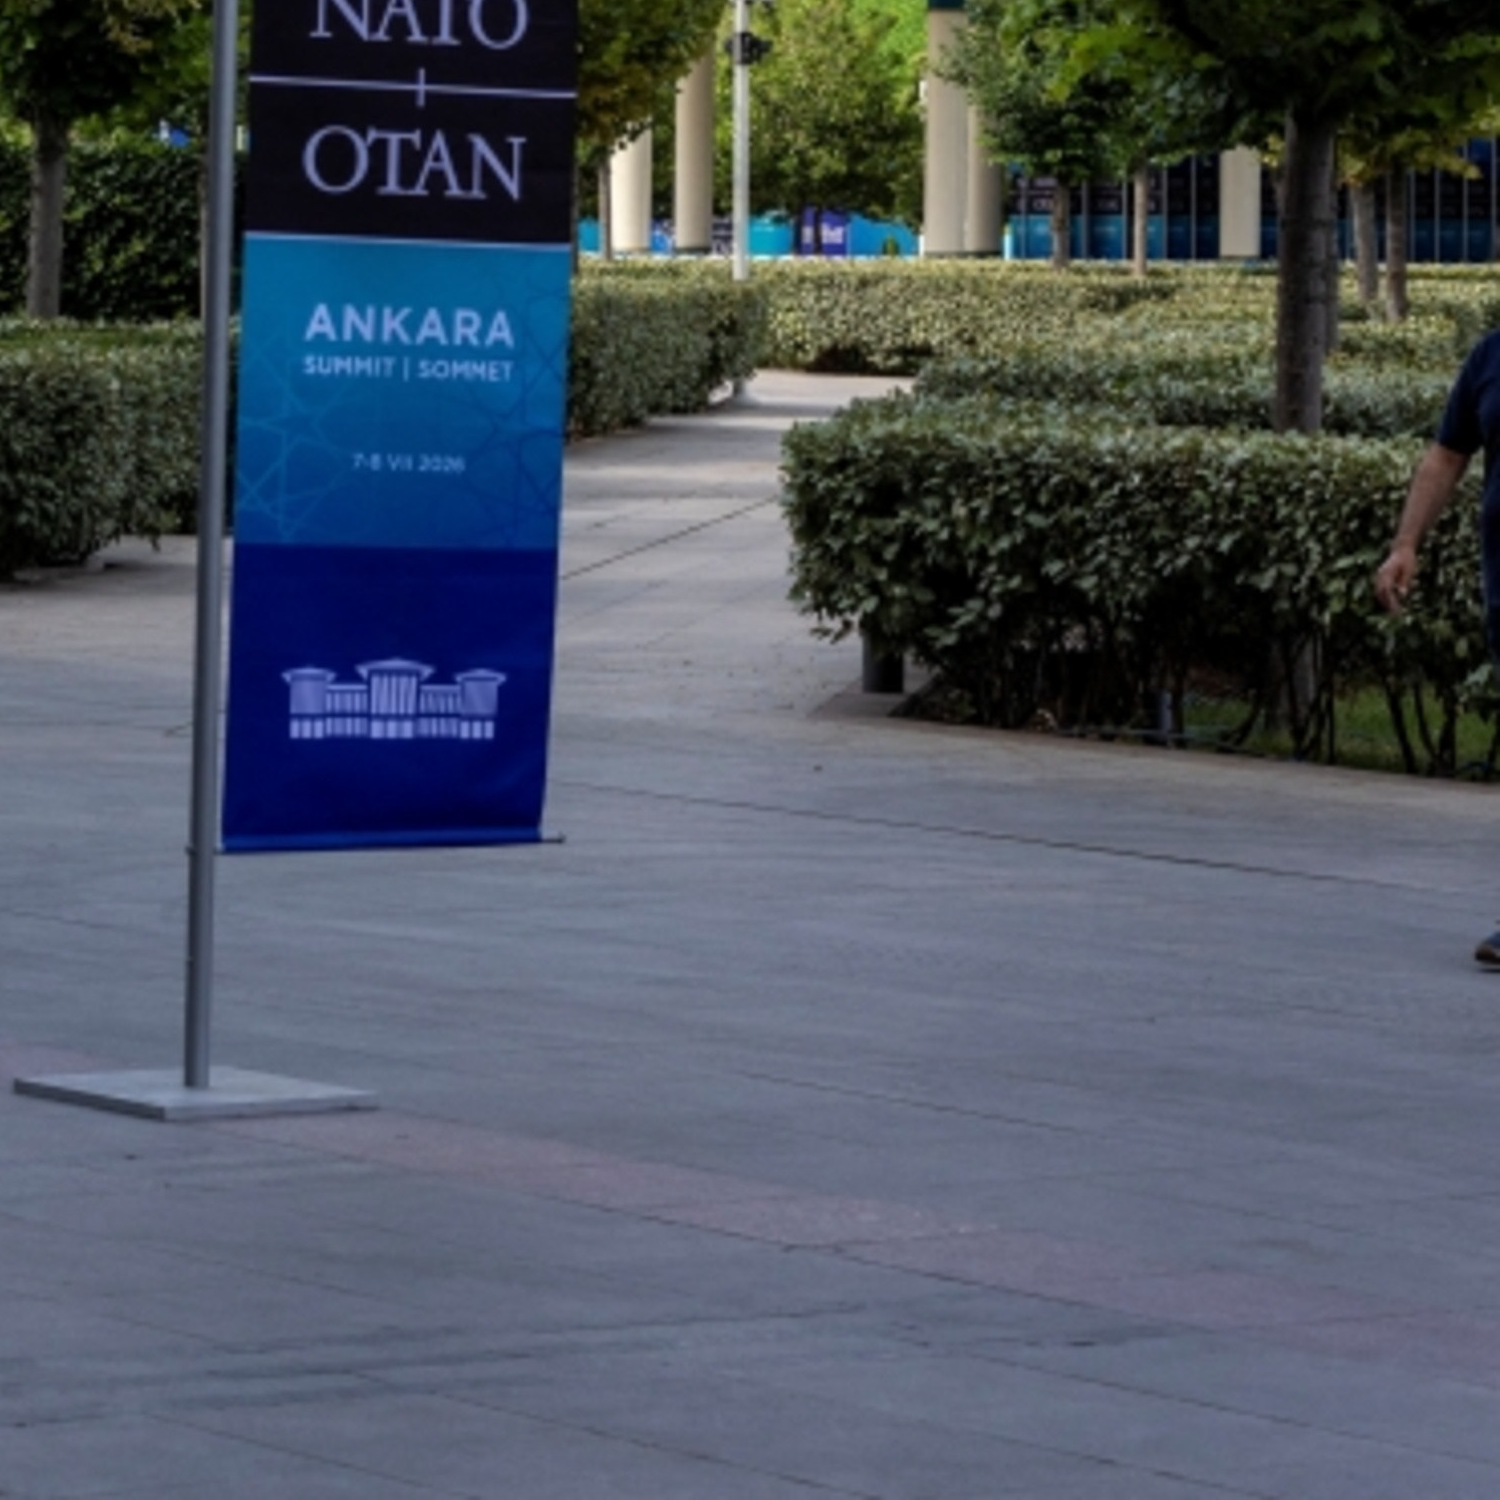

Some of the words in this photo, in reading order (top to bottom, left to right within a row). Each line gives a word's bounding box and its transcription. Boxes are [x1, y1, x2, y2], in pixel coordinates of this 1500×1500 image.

[302, 124, 528, 202] OTAN
[304, 302, 515, 348] ANKARA
[303, 354, 396, 377] SUMMIT
[417, 359, 513, 382] SOMMET
[352, 452, 383, 471] 7-8
[386, 453, 414, 472] VII
[417, 454, 467, 474] 2026
